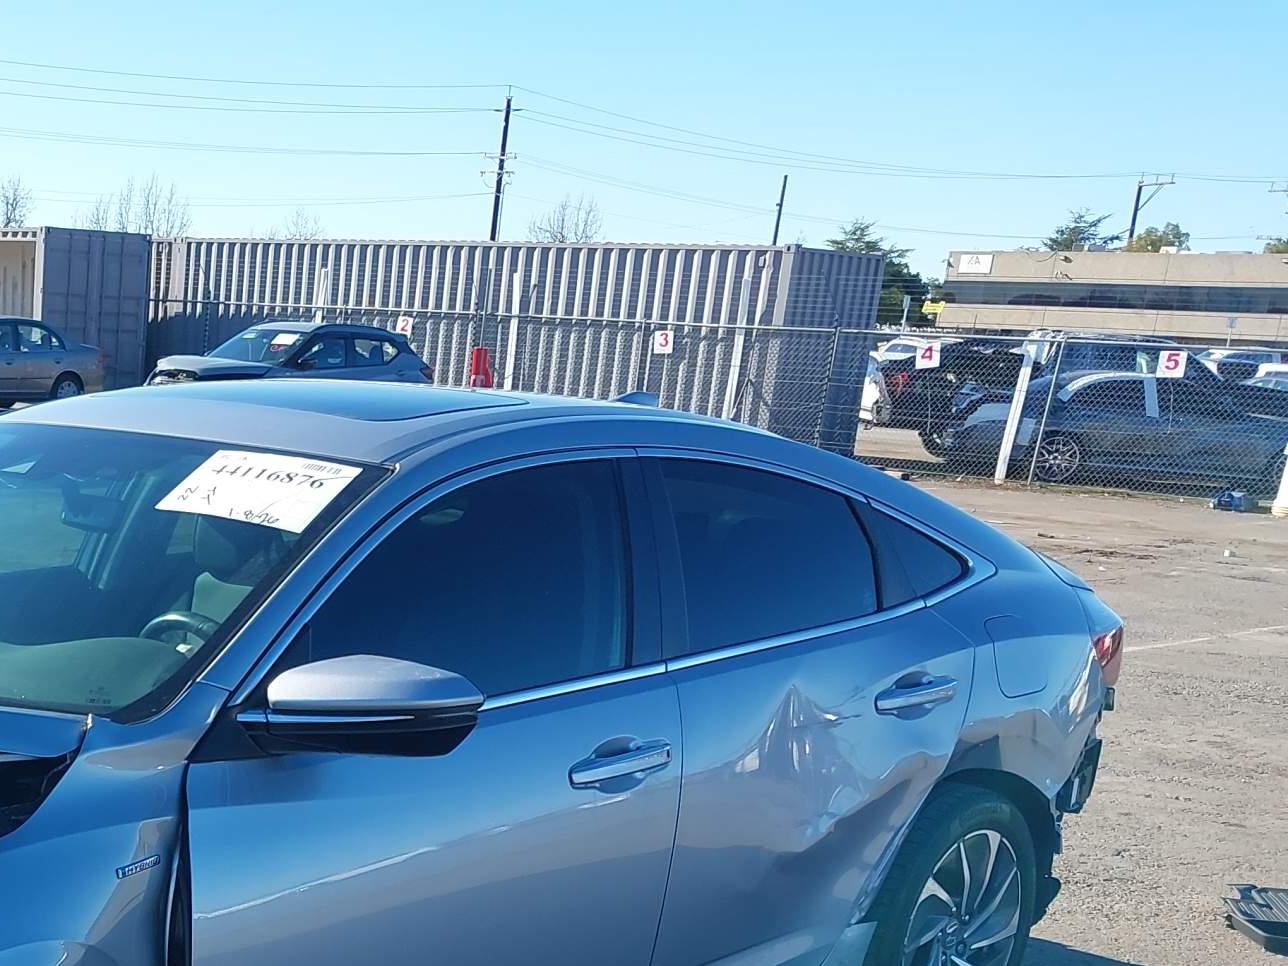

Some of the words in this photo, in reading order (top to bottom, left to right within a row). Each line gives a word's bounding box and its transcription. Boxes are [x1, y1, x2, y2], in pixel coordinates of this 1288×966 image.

[400, 318, 409, 332] 2
[658, 333, 669, 347] 3
[920, 345, 934, 362] 4
[1164, 352, 1181, 370] 5
[212, 464, 324, 489] 44116876
